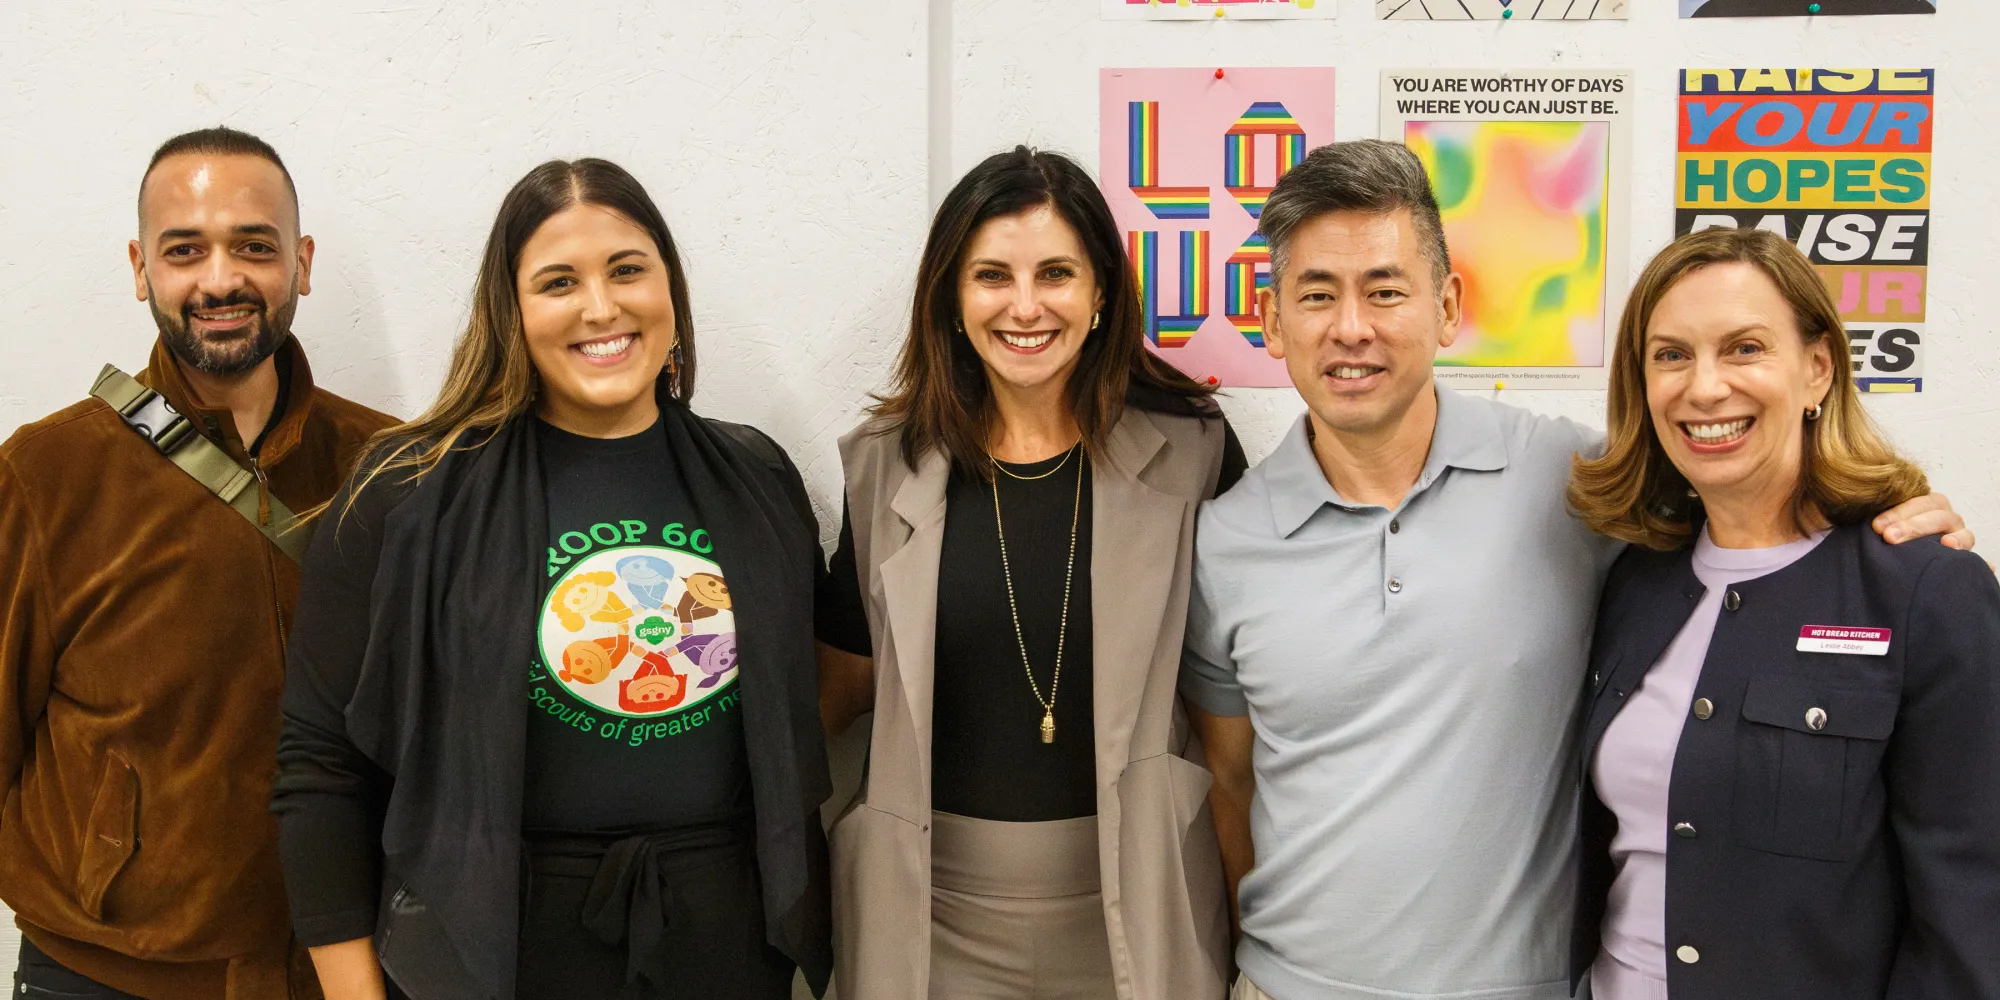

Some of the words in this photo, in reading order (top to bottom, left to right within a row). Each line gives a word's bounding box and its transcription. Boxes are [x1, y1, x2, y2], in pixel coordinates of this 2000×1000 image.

[1392, 78, 1429, 93] YOU
[1431, 78, 1468, 93] ARE
[1470, 78, 1548, 93] WORTHY
[1551, 78, 1576, 93] OF
[1578, 78, 1624, 93] DAYS
[1397, 100, 1461, 114] WHERE
[1464, 100, 1500, 114] YOU
[1502, 100, 1541, 114] CAN
[1543, 100, 1588, 114] JUST
[1590, 100, 1619, 114] BE.
[1685, 101, 1929, 147] YOUR
[1684, 158, 1926, 204] HOPES
[546, 519, 648, 578] ROOP
[638, 624, 673, 638] gsgny
[527, 686, 596, 733] scouts
[600, 718, 629, 740] of
[628, 705, 712, 747] greater
